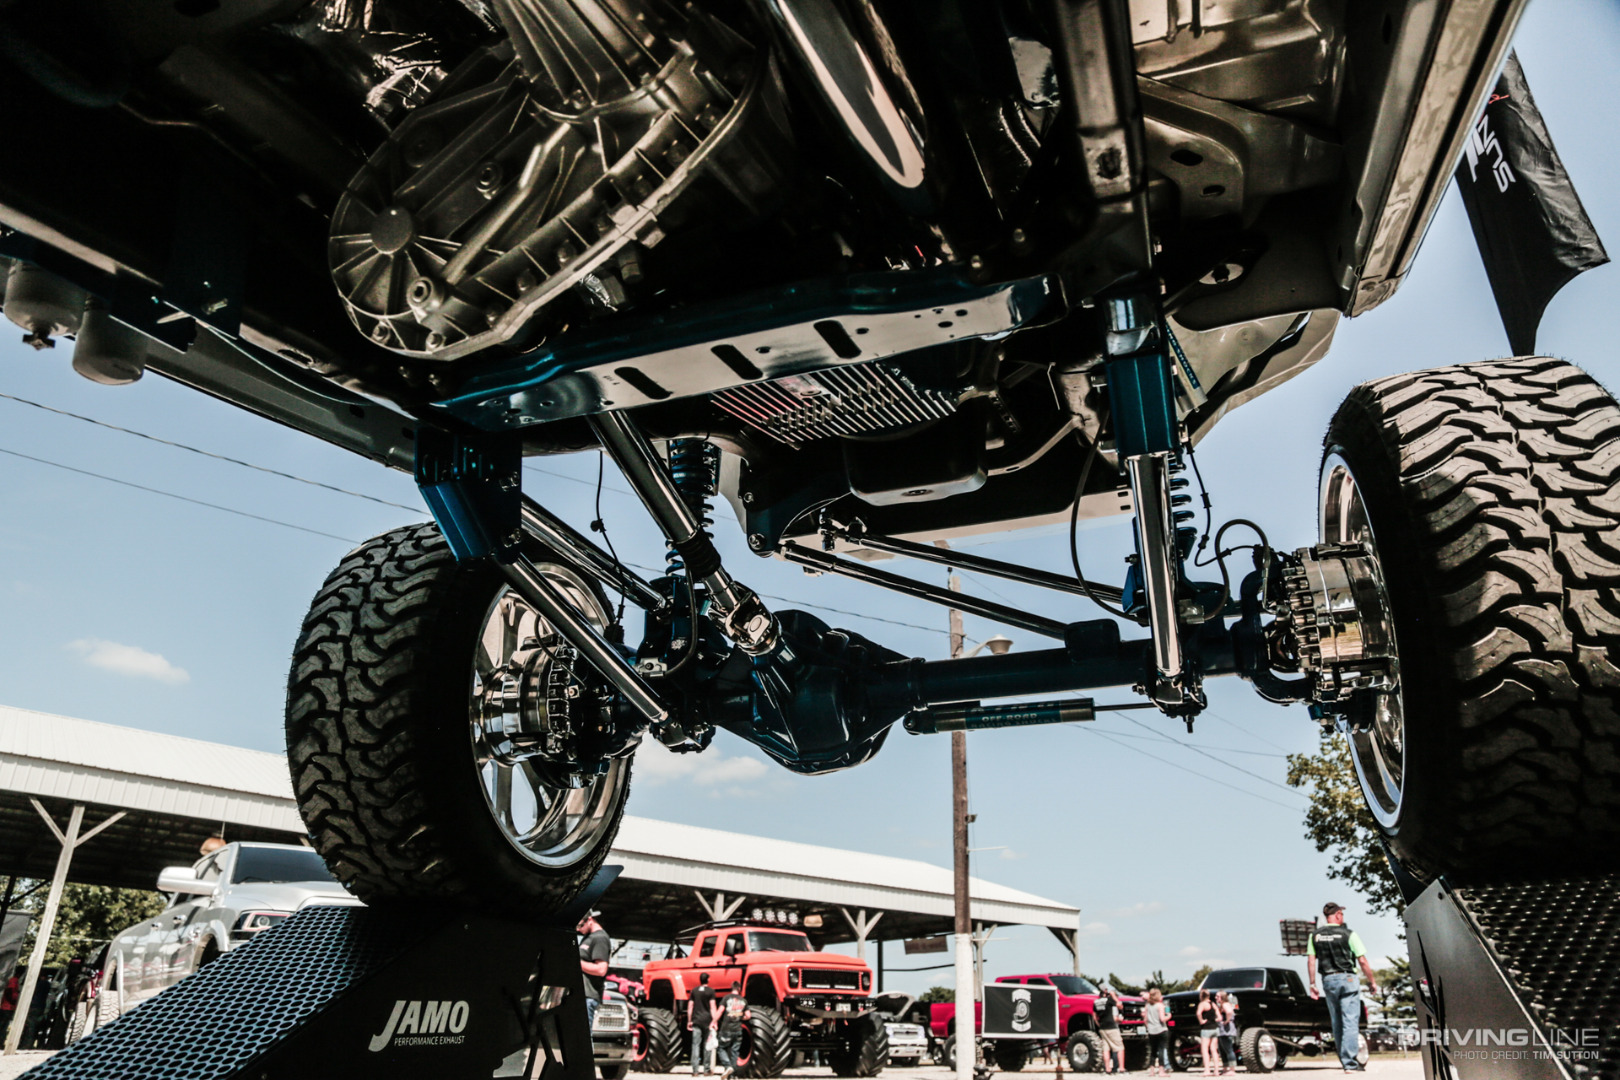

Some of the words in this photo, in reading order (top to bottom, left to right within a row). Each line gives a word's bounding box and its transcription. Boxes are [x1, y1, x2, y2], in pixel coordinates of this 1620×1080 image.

[368, 1000, 470, 1053] JAMO
[394, 1036, 438, 1046] PERFORMANCE
[439, 1035, 465, 1045] EXHAUST
